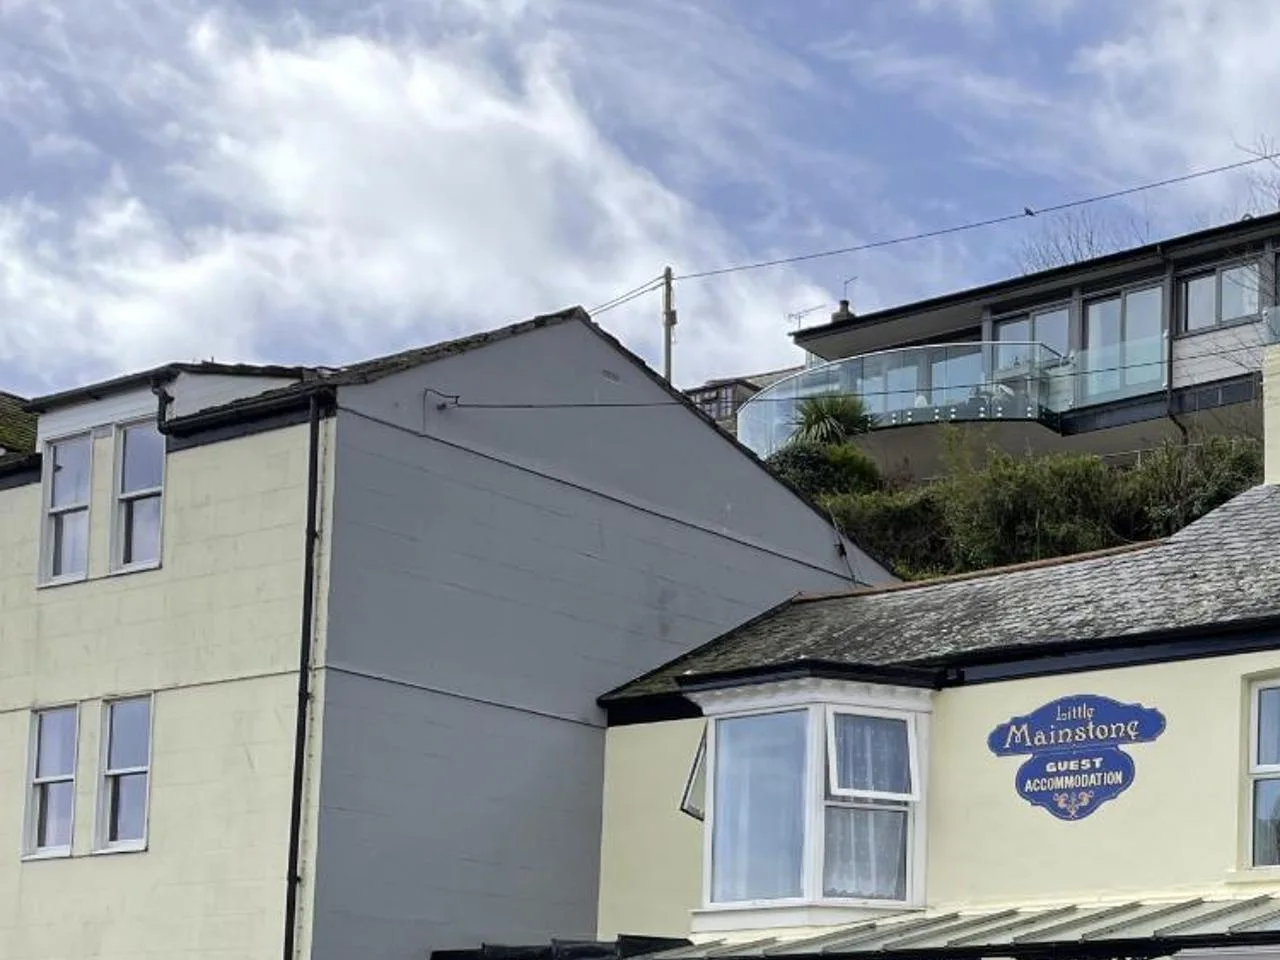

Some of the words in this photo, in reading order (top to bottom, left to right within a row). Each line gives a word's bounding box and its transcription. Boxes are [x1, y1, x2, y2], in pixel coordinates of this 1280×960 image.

[1055, 702, 1096, 721] Little
[1003, 720, 1140, 748] Mainstone
[1045, 757, 1104, 772] GUEST
[1024, 771, 1122, 792] ACCOMMODATION
